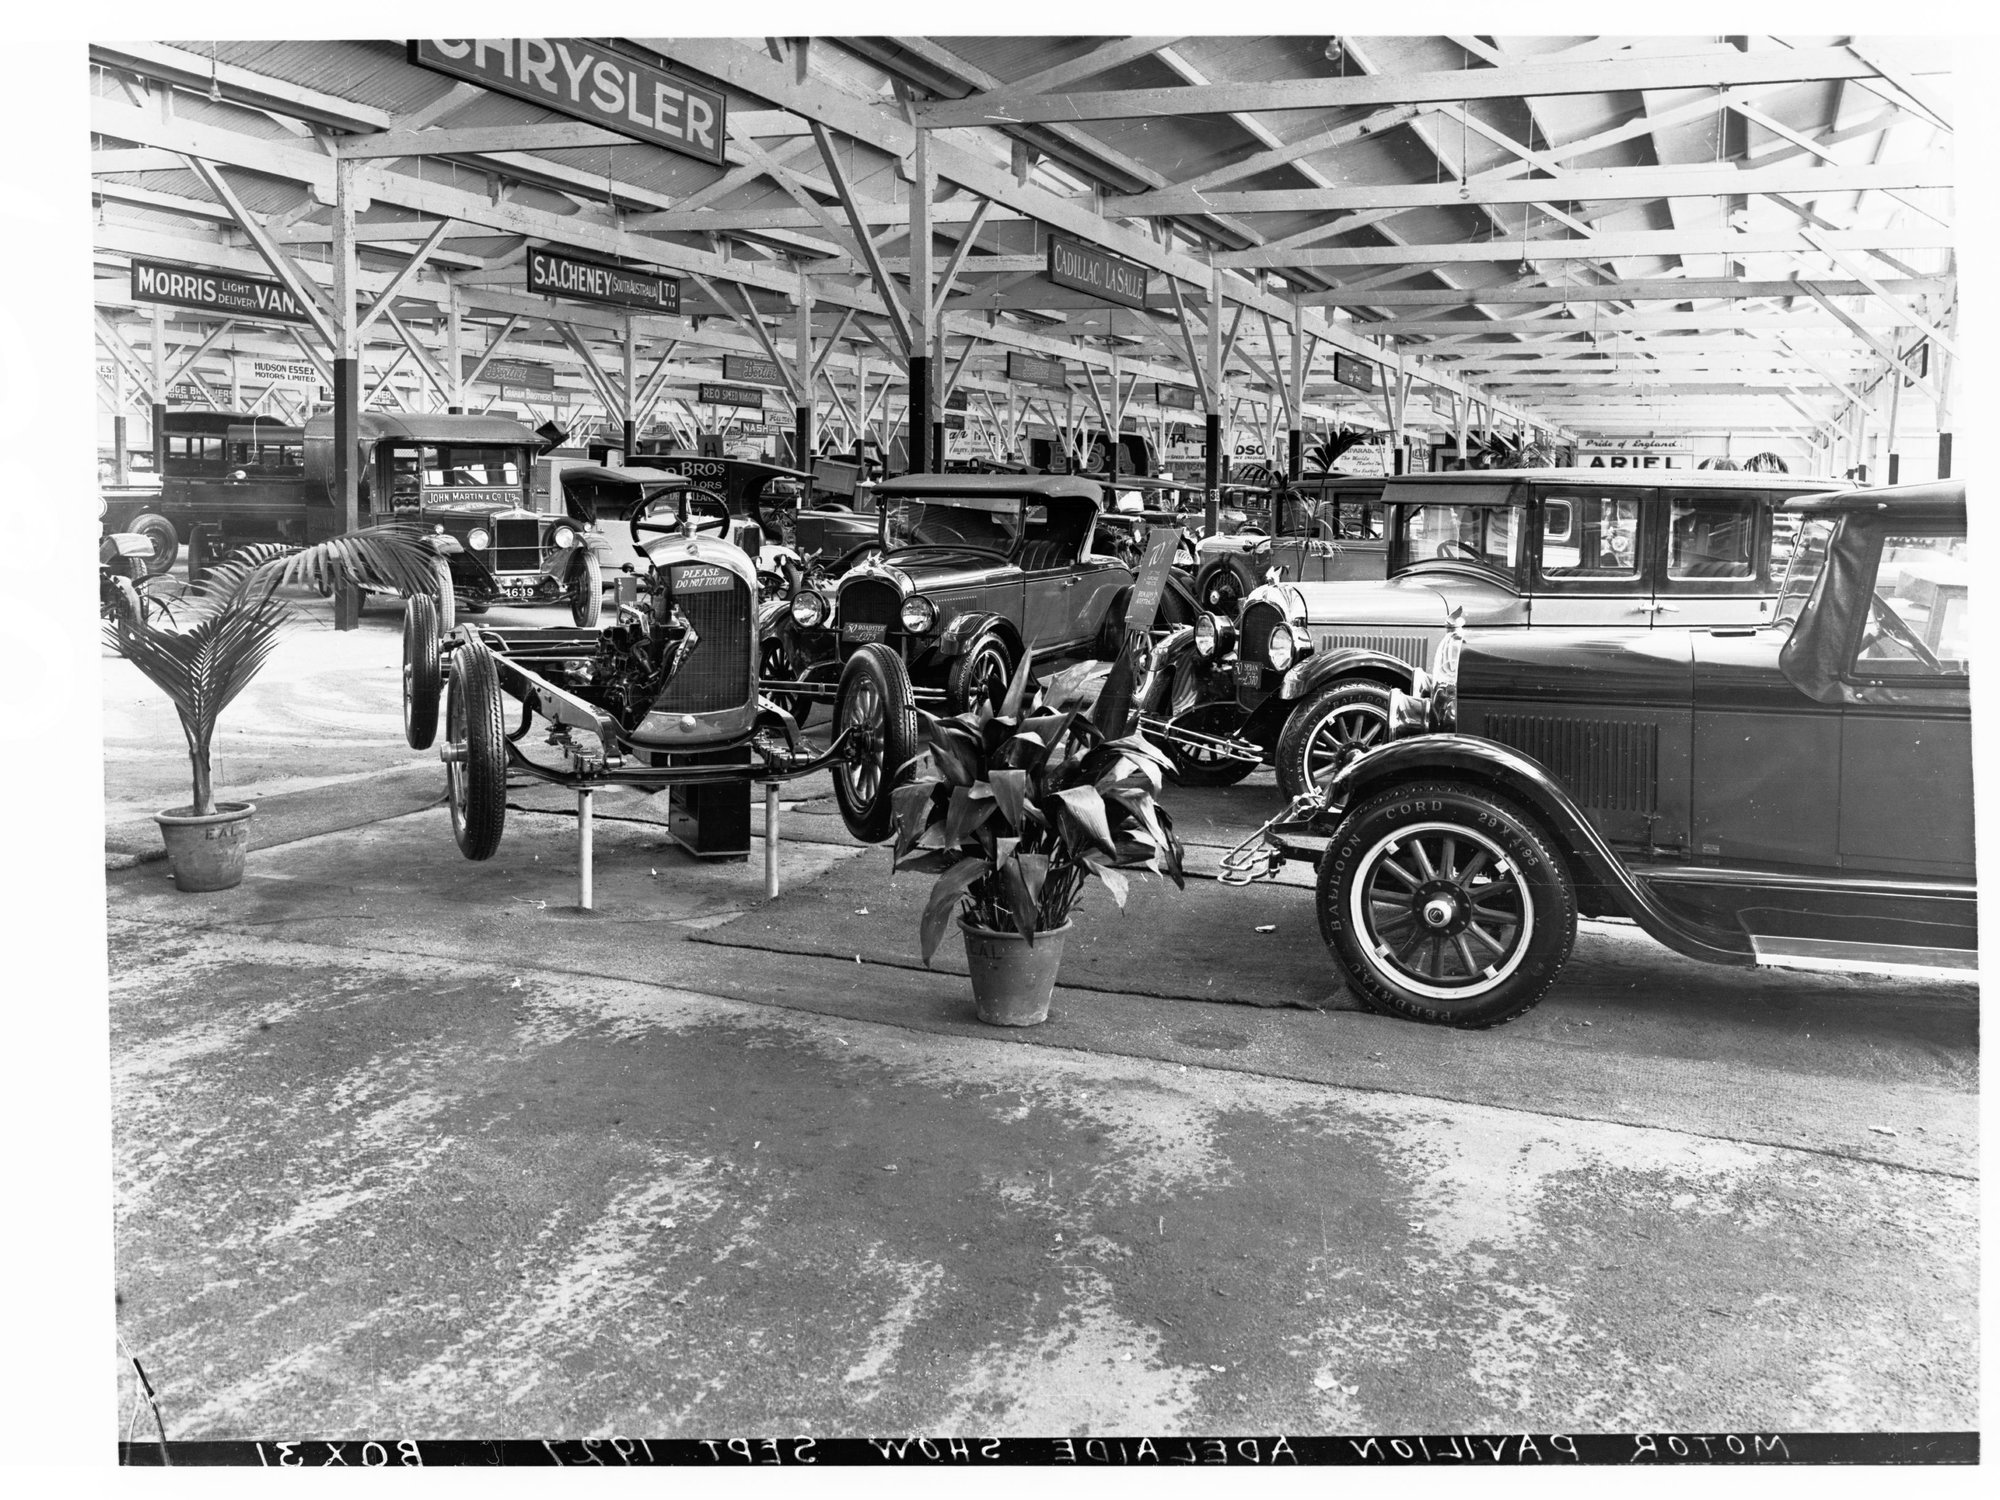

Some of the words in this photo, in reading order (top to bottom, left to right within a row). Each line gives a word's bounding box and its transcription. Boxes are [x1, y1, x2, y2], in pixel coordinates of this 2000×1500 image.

[138, 266, 217, 302] MORRIS
[222, 281, 250, 295] LIGHT
[218, 294, 257, 309] DELIVERY
[254, 362, 287, 372] HUDSON
[288, 365, 315, 375] ESSEX
[254, 371, 285, 380] MOTORS
[287, 375, 316, 383] LIMITED
[703, 387, 720, 398] REO
[722, 389, 738, 401] SPEED
[743, 423, 768, 433] NASH
[1585, 439, 1613, 448] Pride
[1617, 440, 1628, 449] of
[681, 461, 725, 477] BROS
[1590, 456, 1682, 469] ARIEL
[427, 492, 450, 504] JOHN
[452, 492, 484, 502] MARTIN
[682, 568, 720, 579] PLEASE
[675, 580, 689, 589] DO
[689, 577, 705, 588] NOT
[705, 576, 730, 586] TOUCH
[505, 588, 534, 597] 4639
[1386, 800, 1443, 820] CORD
[1477, 811, 1498, 828] 29
[1500, 826, 1513, 837] X
[1329, 833, 1362, 932] BALLOON
[1347, 962, 1452, 1022] PERDRIAU
